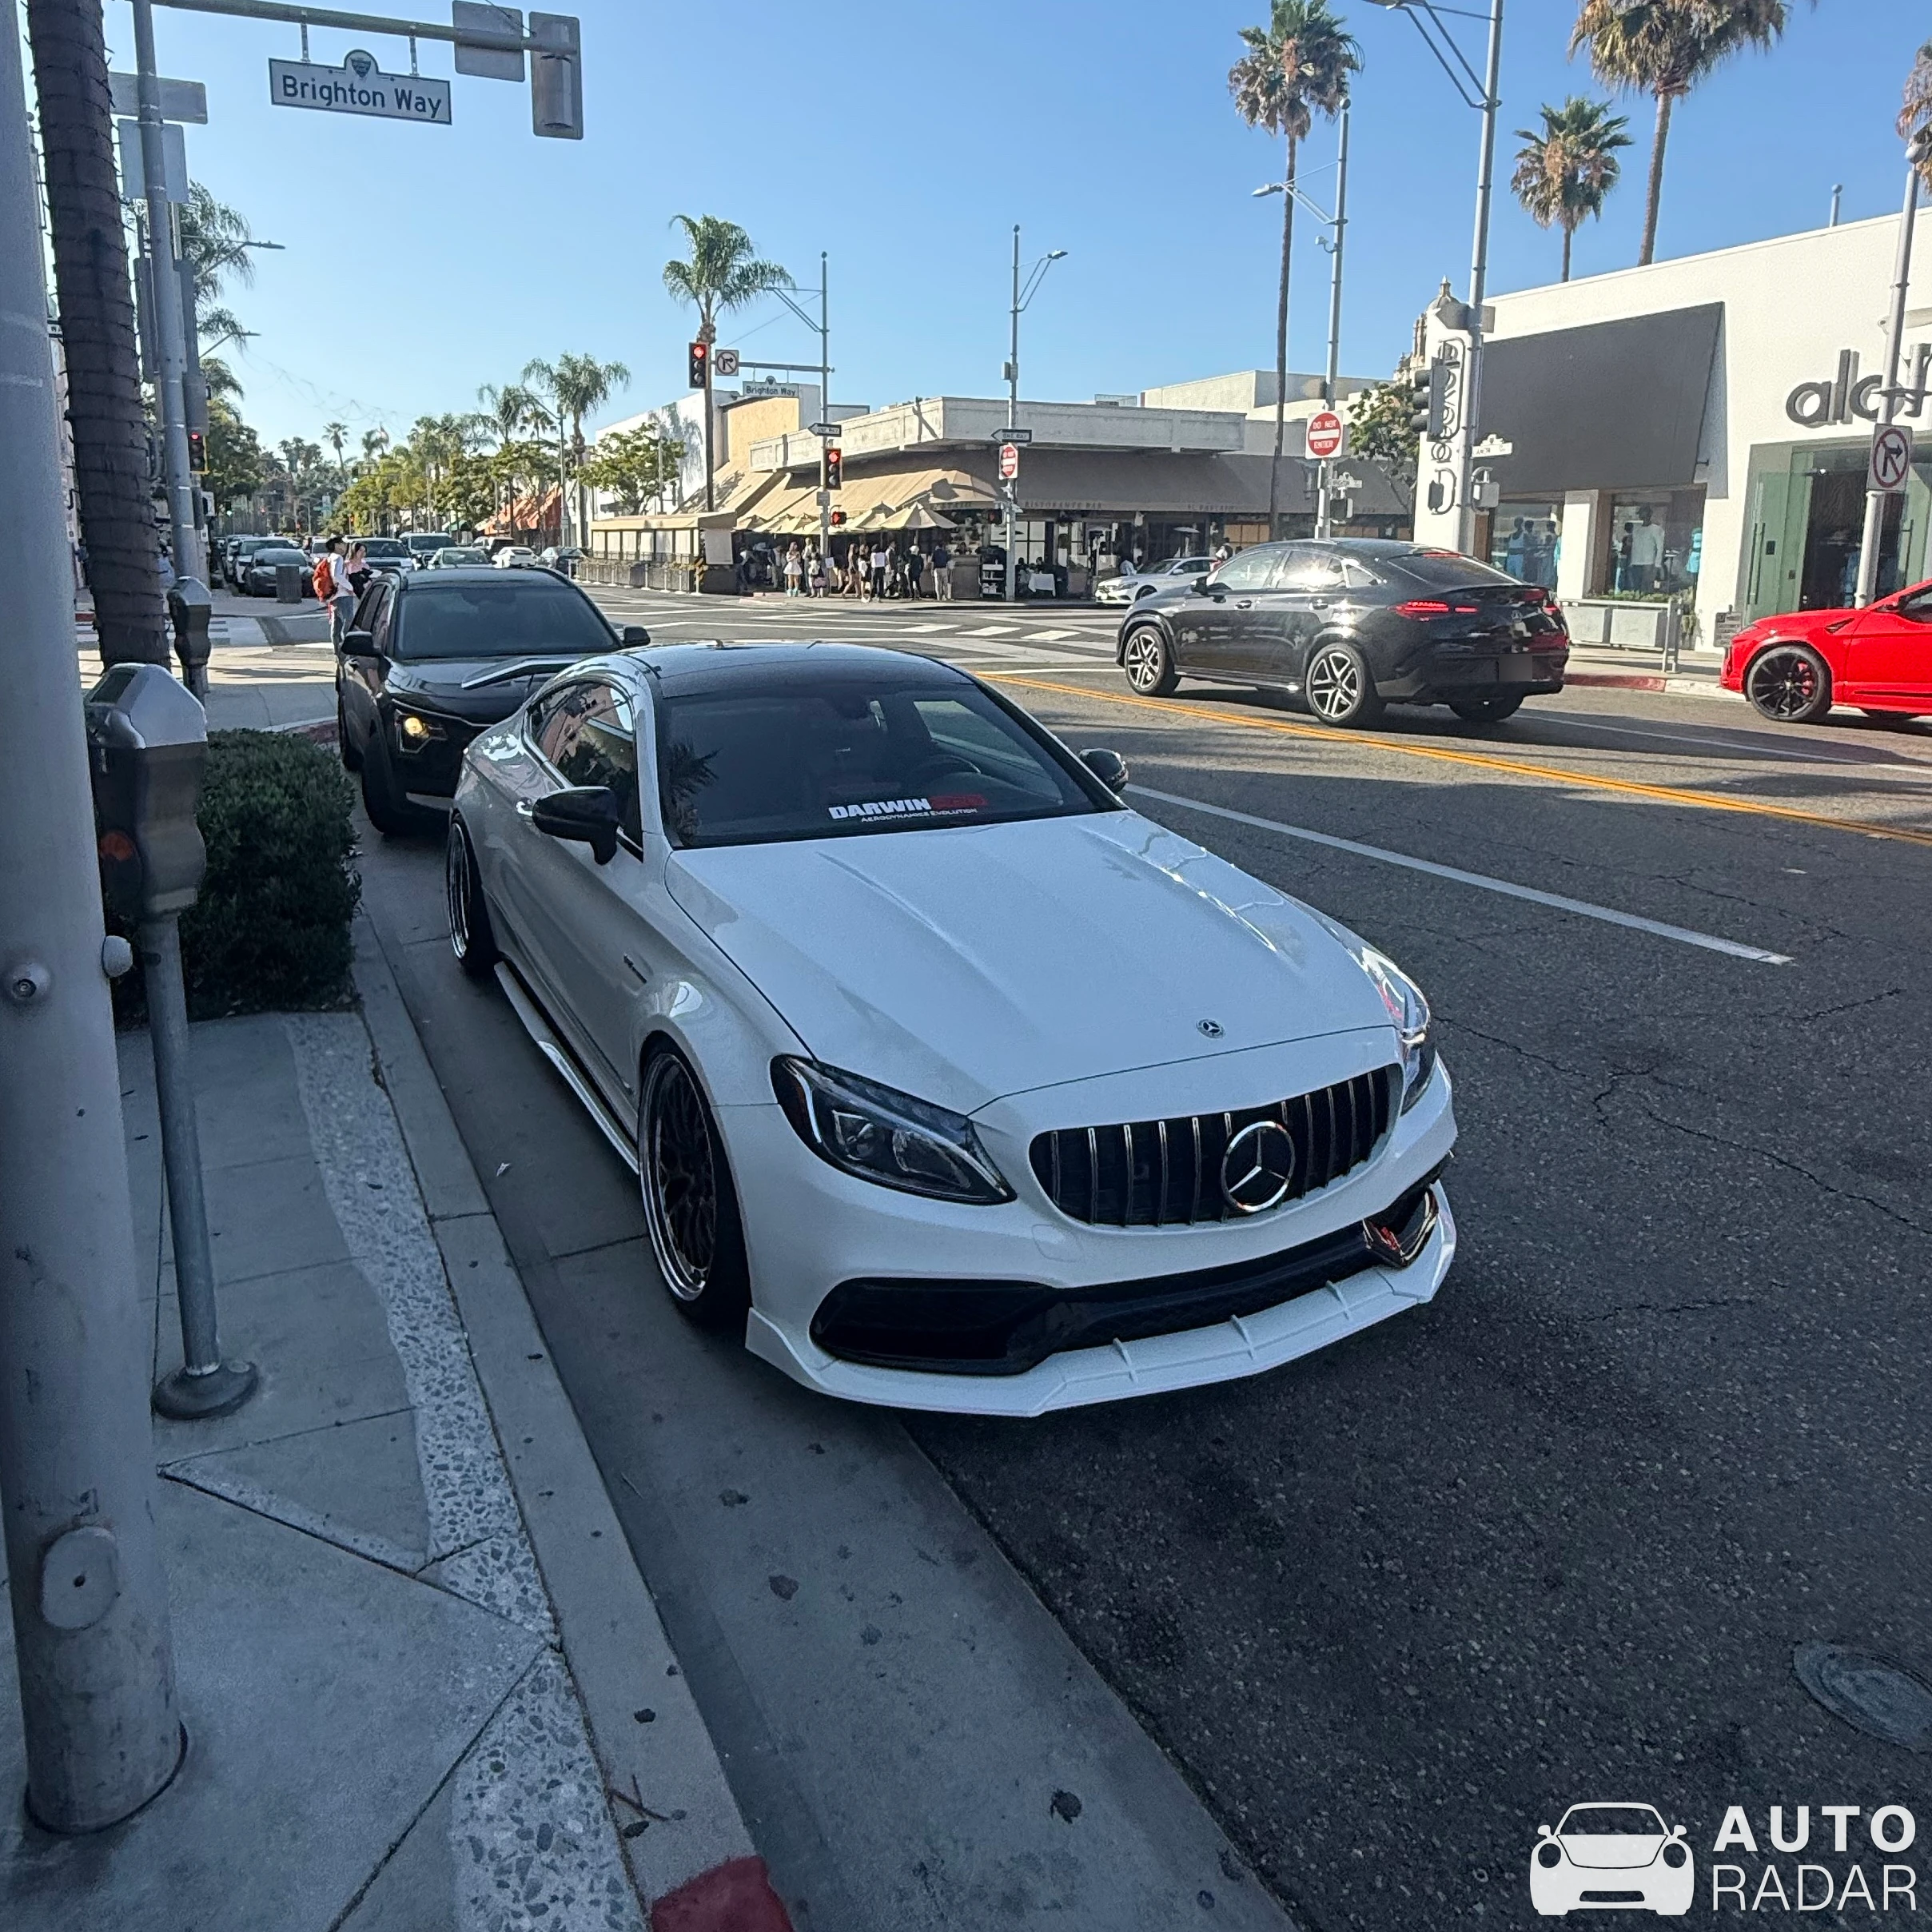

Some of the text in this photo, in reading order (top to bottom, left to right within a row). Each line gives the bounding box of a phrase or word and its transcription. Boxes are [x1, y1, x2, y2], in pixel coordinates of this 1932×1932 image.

[281, 74, 442, 119] Brighton Way
[746, 385, 796, 396] Brighton Way
[828, 798, 932, 820] DARWIN
